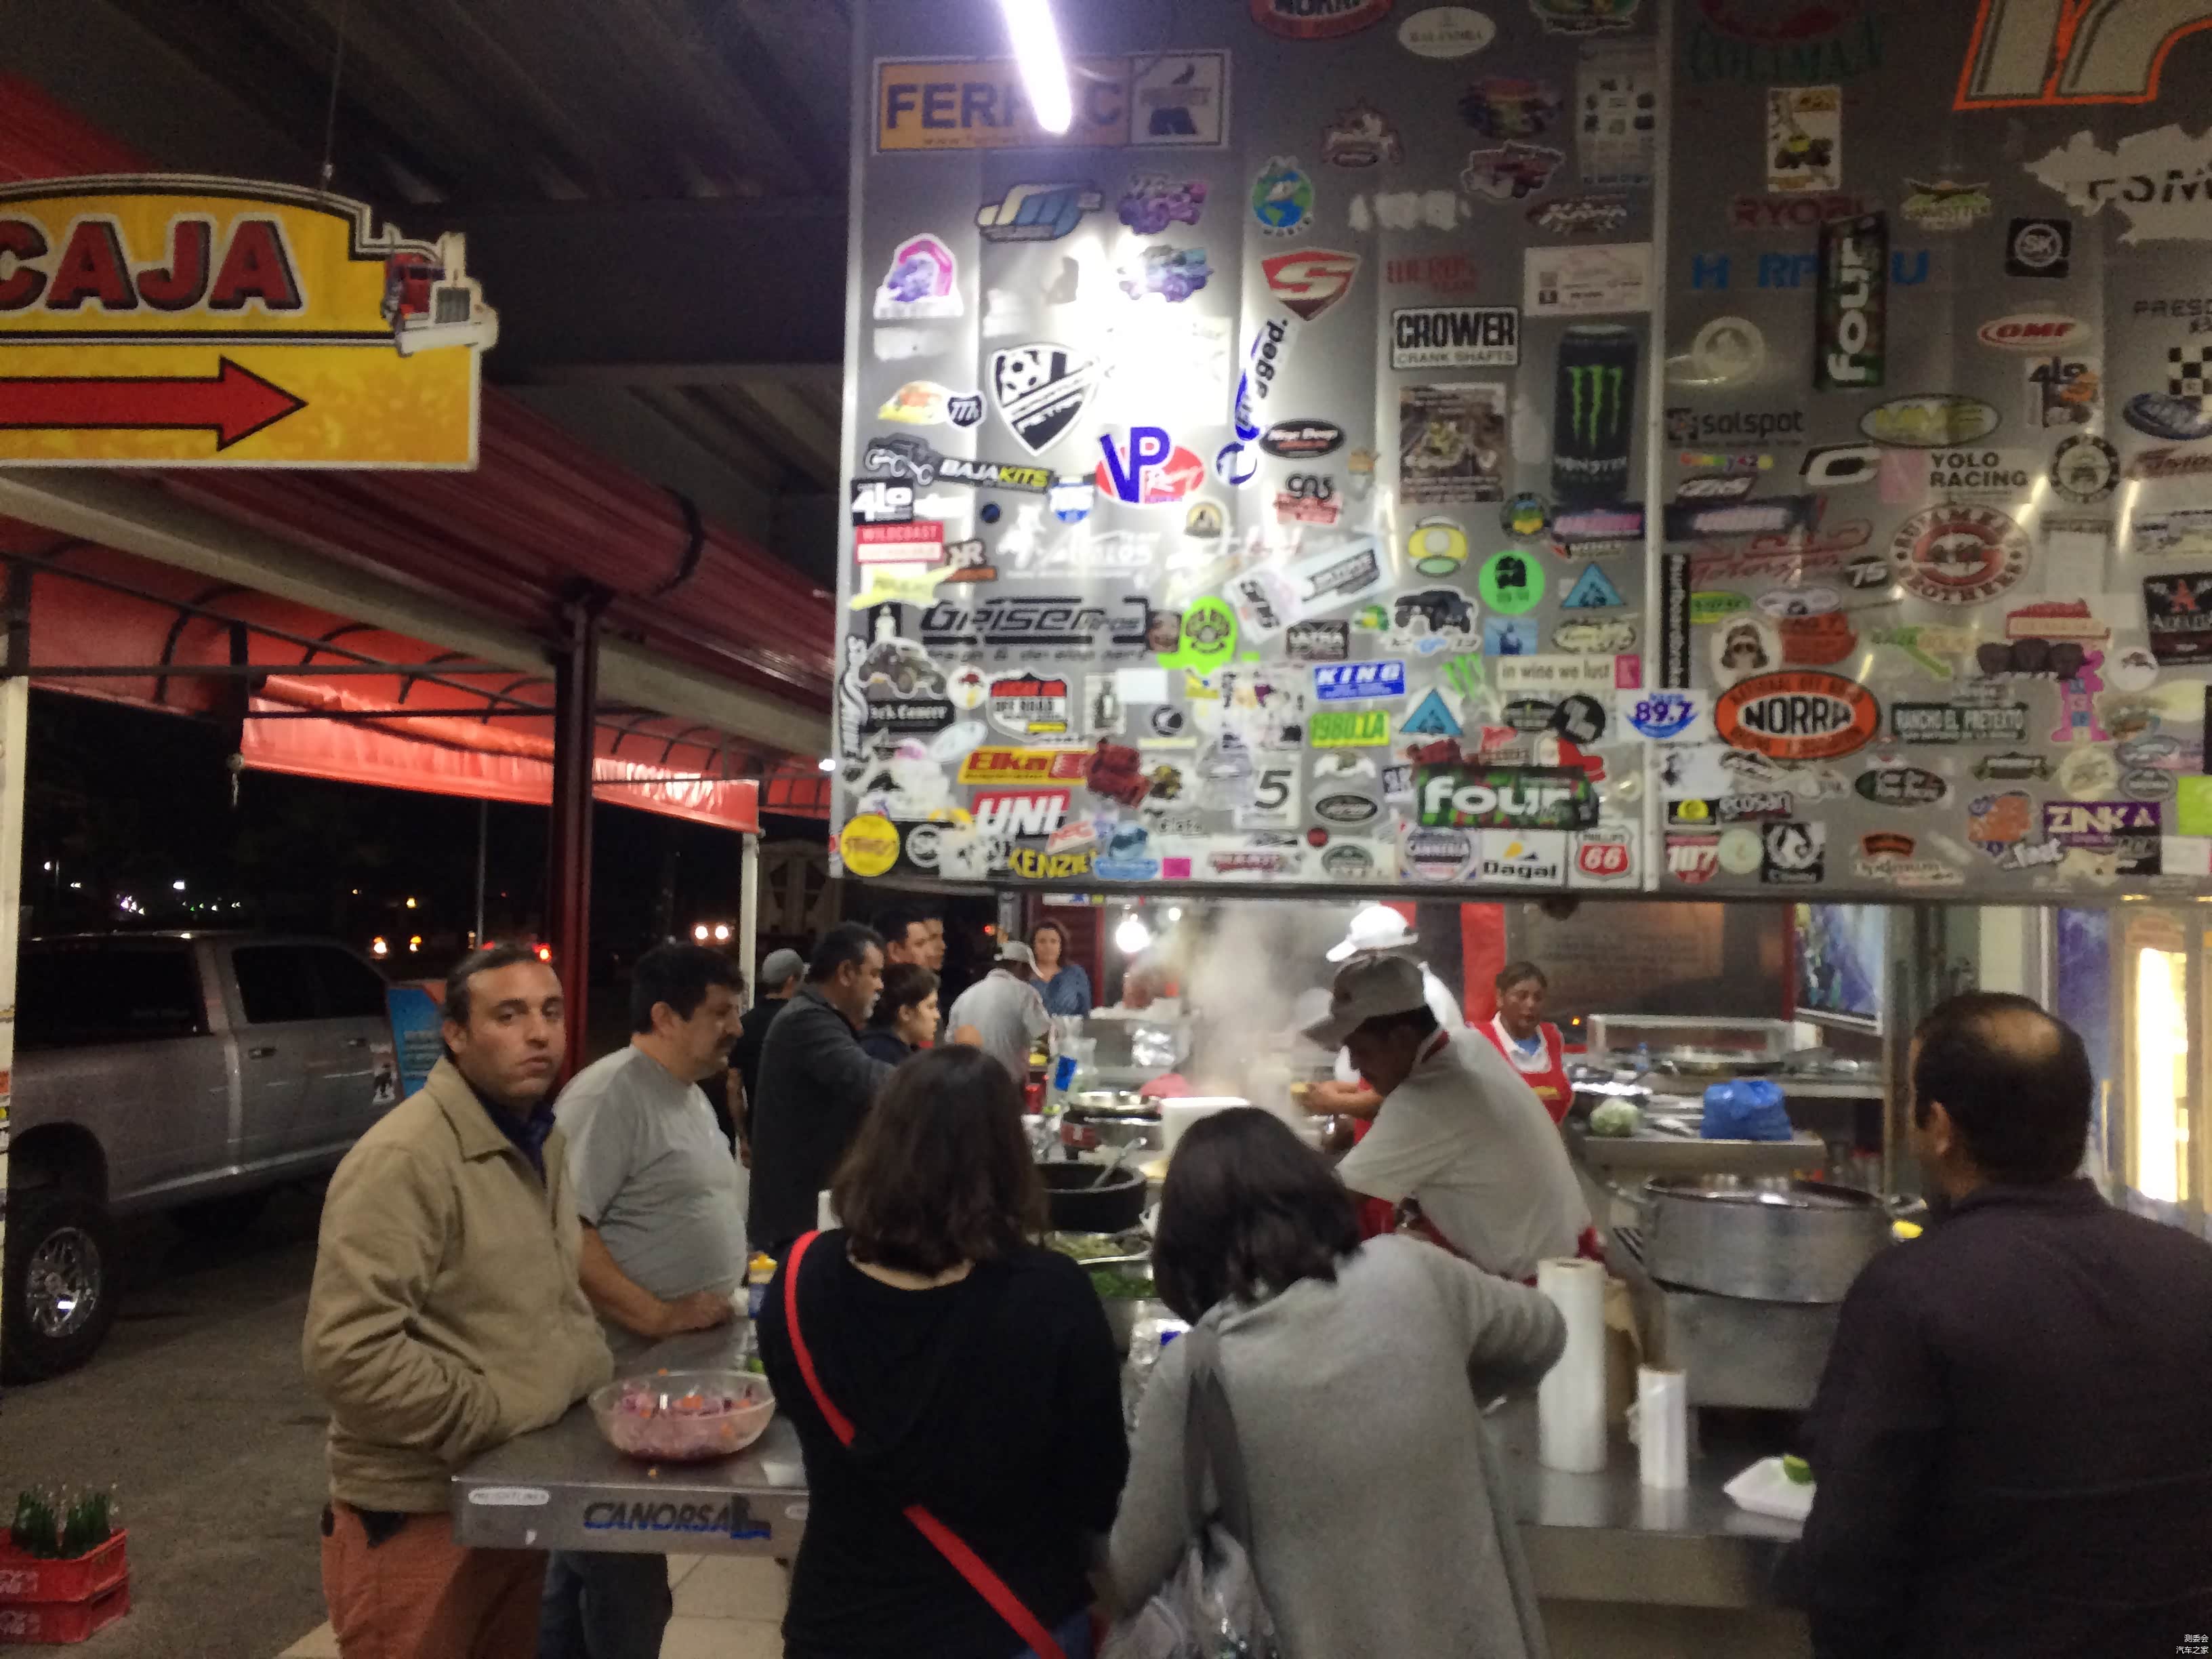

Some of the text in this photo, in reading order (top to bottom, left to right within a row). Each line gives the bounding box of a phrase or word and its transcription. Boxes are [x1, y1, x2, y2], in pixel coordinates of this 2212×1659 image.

[0, 218, 303, 312] CAJA
[1395, 311, 1515, 349] CROWER
[1397, 350, 1514, 363] CRANK SHAFTS
[1702, 409, 1805, 437] solspot
[1099, 426, 1172, 504] VP
[1930, 451, 2000, 469] YOLO
[1929, 470, 2028, 487] RACING
[1317, 662, 1402, 684] KING
[1635, 700, 1694, 722] 89.7
[1744, 695, 1853, 735] NORRA
[1254, 769, 1291, 810] 5
[1425, 775, 1572, 815] four
[975, 796, 1066, 836] UNI
[1584, 846, 1622, 869] 66
